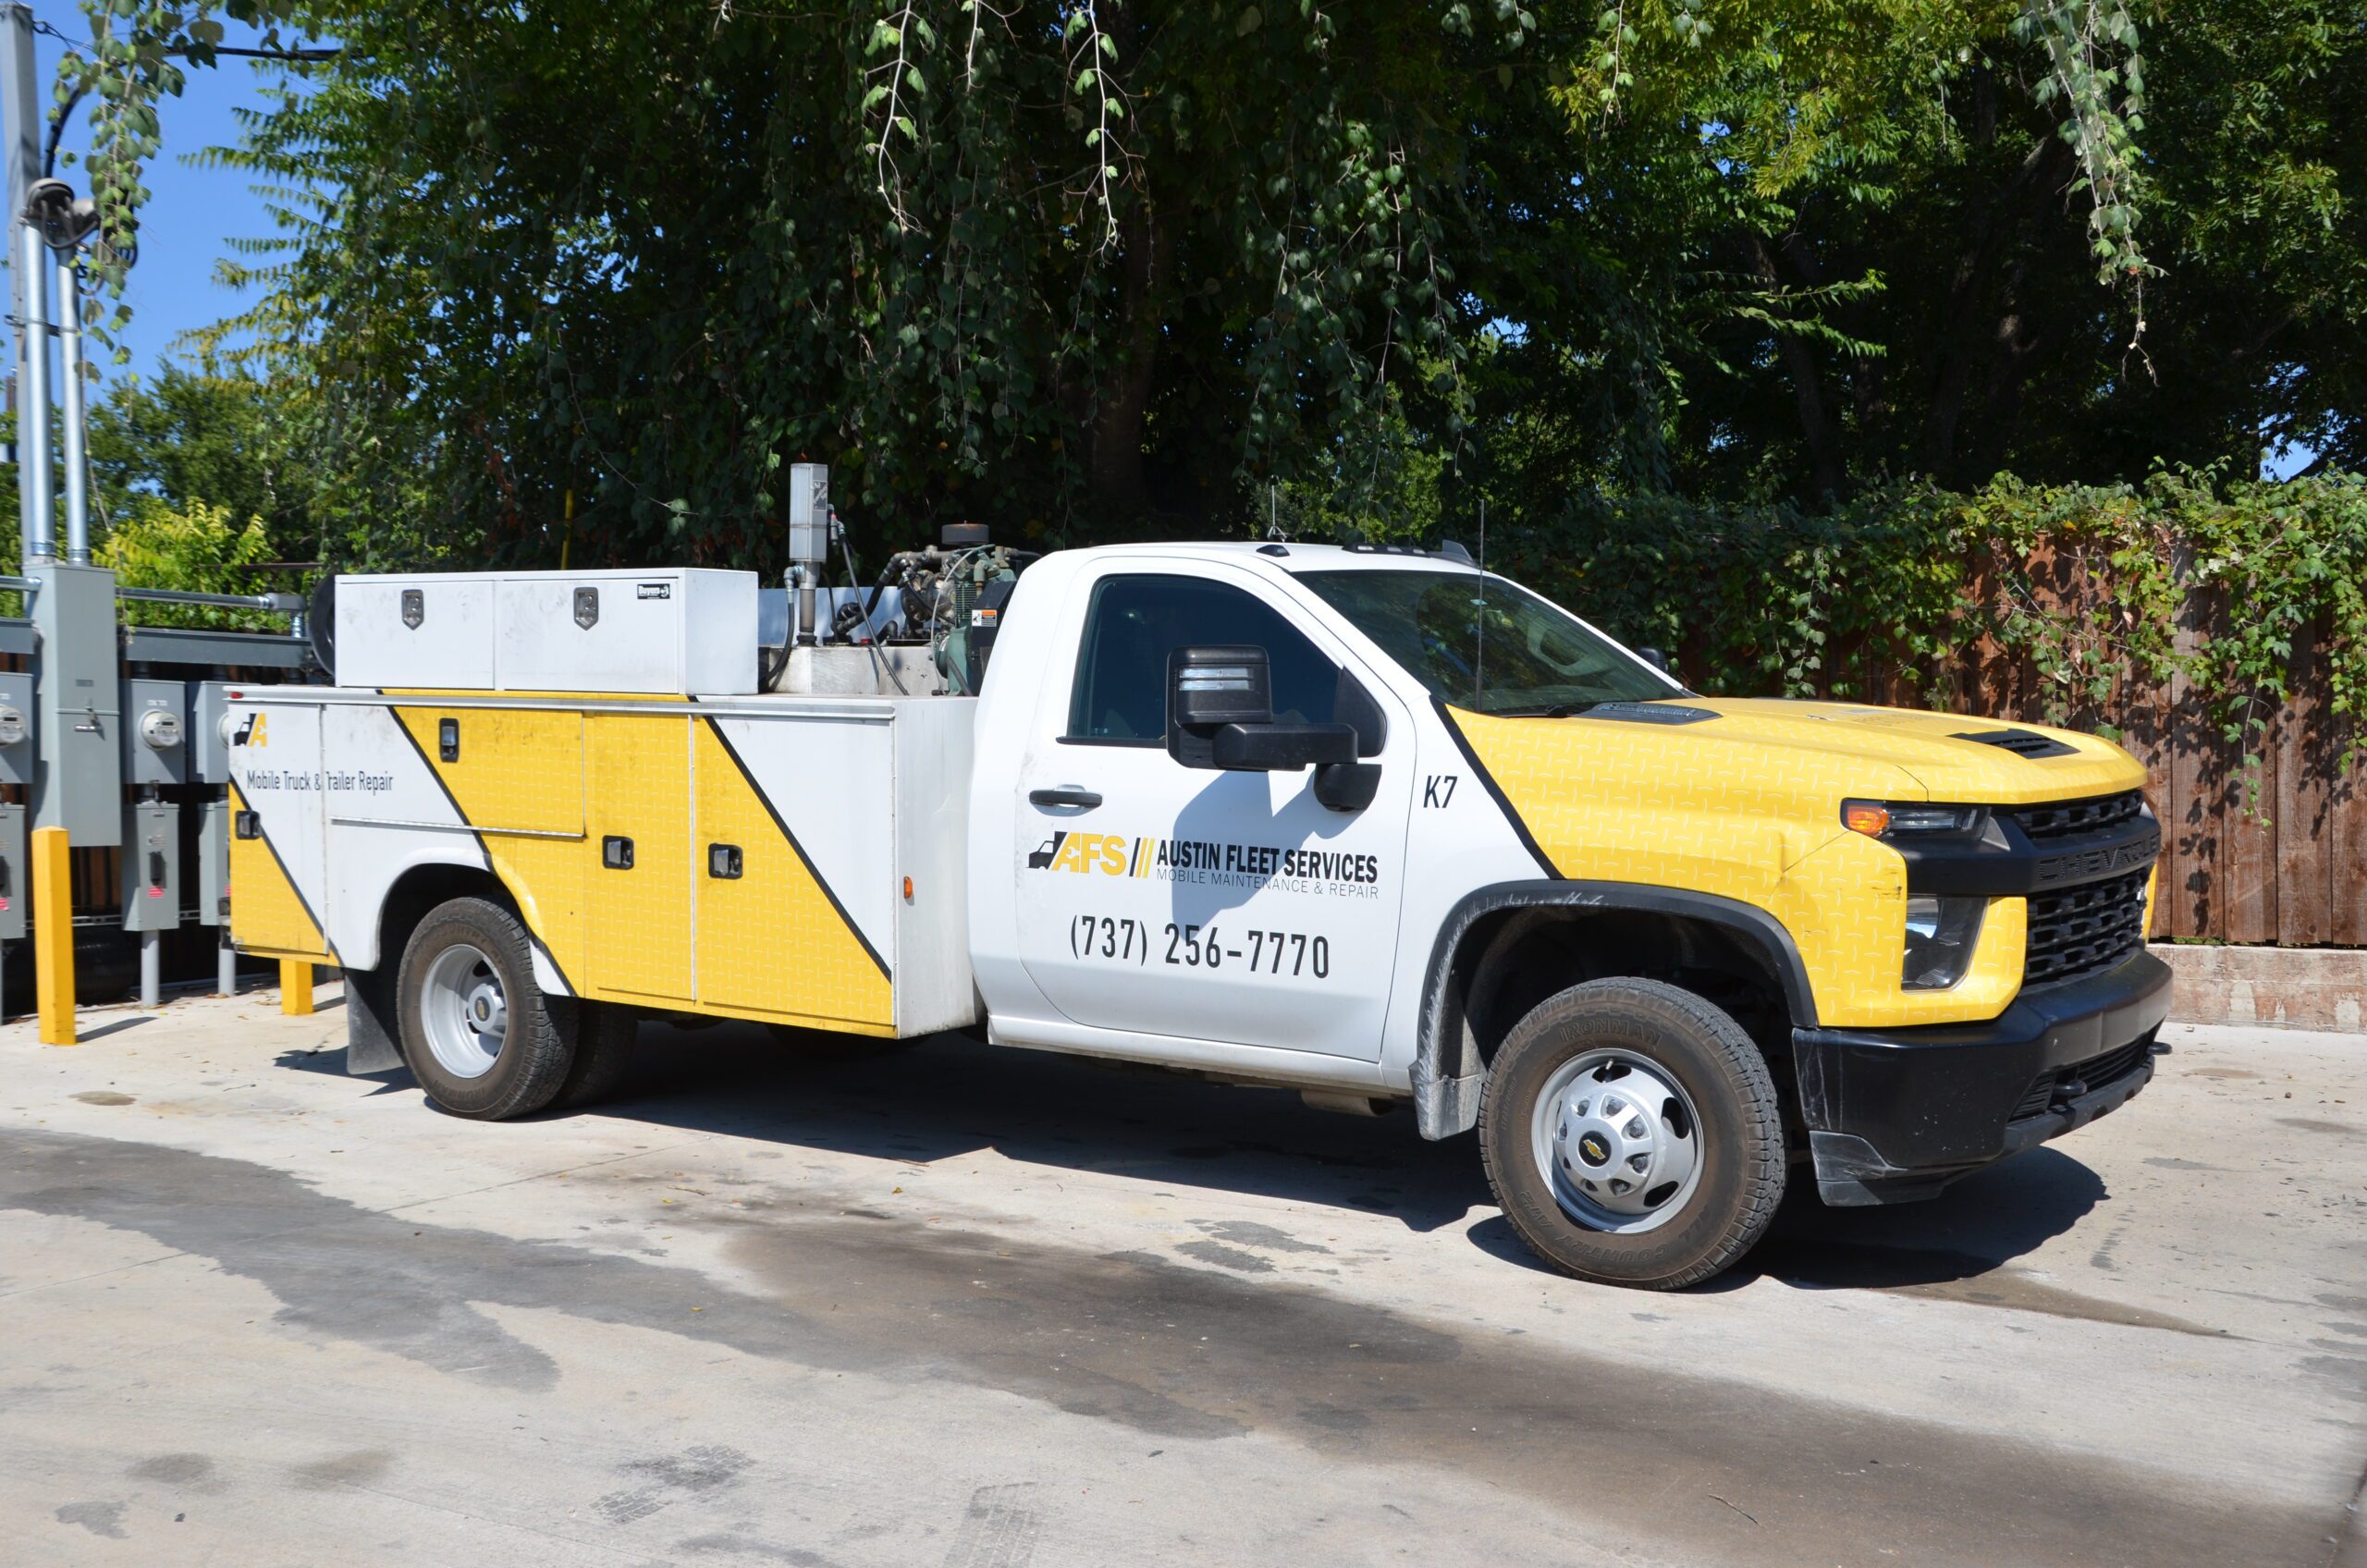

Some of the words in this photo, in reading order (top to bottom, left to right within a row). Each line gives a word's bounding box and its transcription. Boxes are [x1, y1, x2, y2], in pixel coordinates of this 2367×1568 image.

[247, 770, 280, 790] Mobile
[283, 771, 312, 790] Truck
[314, 773, 322, 790] &
[359, 770, 394, 796] Repair
[1423, 775, 1458, 808] K7
[1051, 832, 1127, 876] AFS
[1157, 839, 1221, 871] AUSTIN
[1226, 844, 1280, 876] FLEET
[1283, 849, 1378, 884] SERVICES
[2038, 831, 2161, 881] CHEVROLE
[1157, 868, 1207, 885] MOBILE
[1211, 873, 1308, 893] MAINTENANCE
[1314, 881, 1324, 895] &
[1330, 884, 1379, 900] REPAIR
[1071, 914, 1147, 967] (737)
[1164, 923, 1330, 979] 256-7770
[1559, 1018, 1663, 1047] IRONMAN
